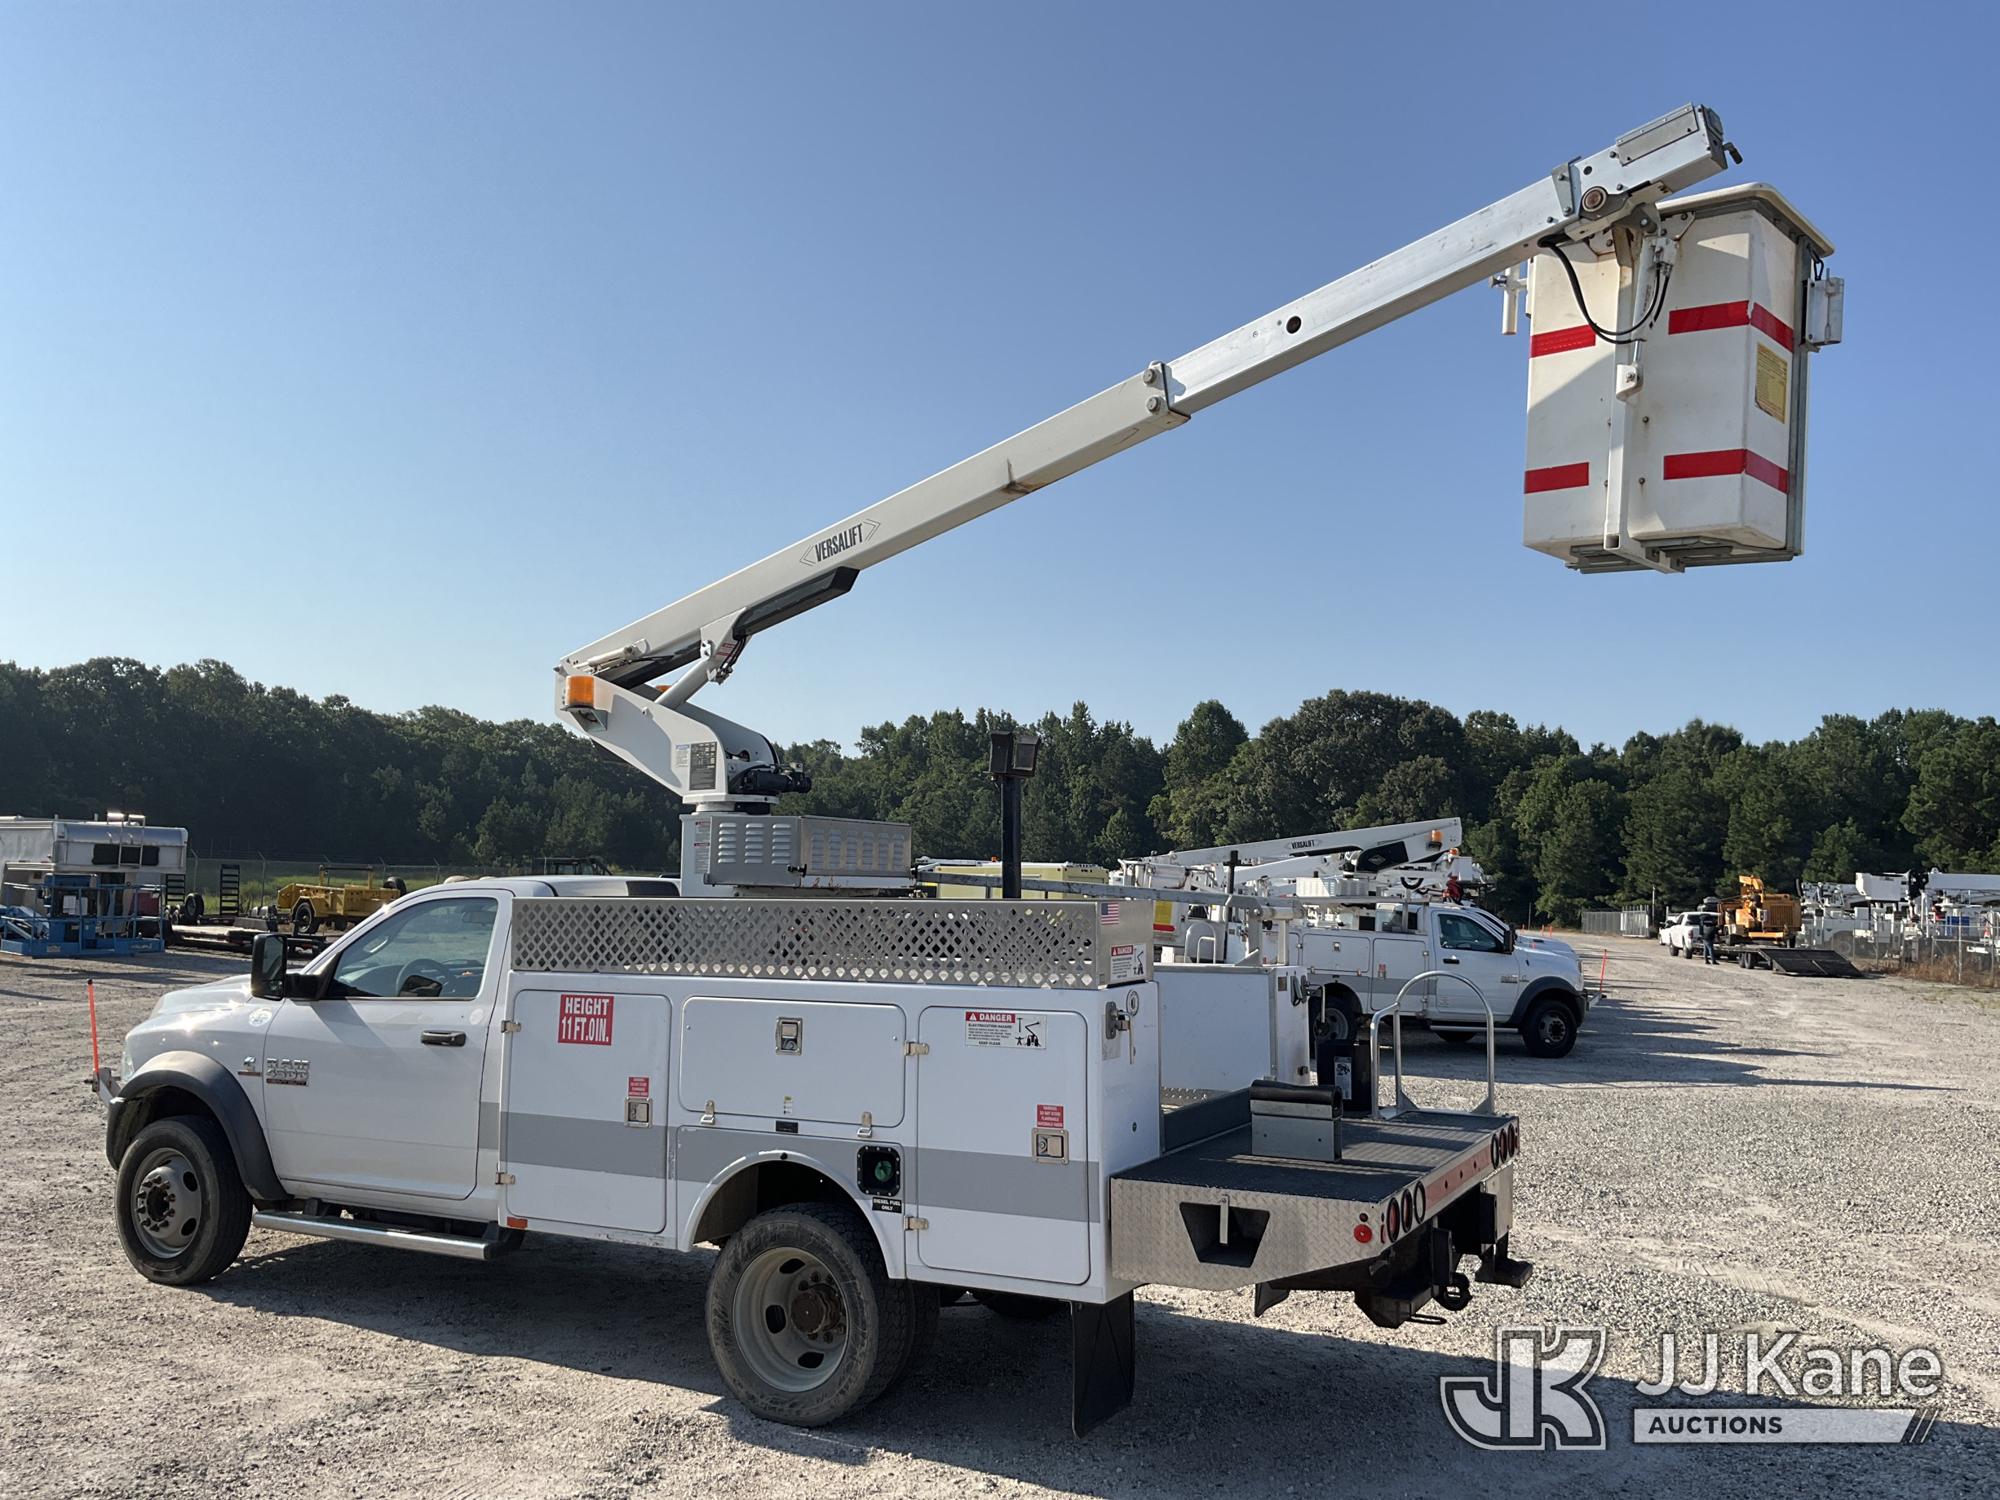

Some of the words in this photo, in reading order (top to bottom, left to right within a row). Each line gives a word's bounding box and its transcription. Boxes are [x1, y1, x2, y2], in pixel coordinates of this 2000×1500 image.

[815, 523, 863, 562] VERSALIFT
[1291, 839, 1315, 849] VERSALIFT
[565, 997, 609, 1015] HEIGHT
[979, 1013, 1012, 1022] DANGER
[562, 1016, 572, 1040] 11
